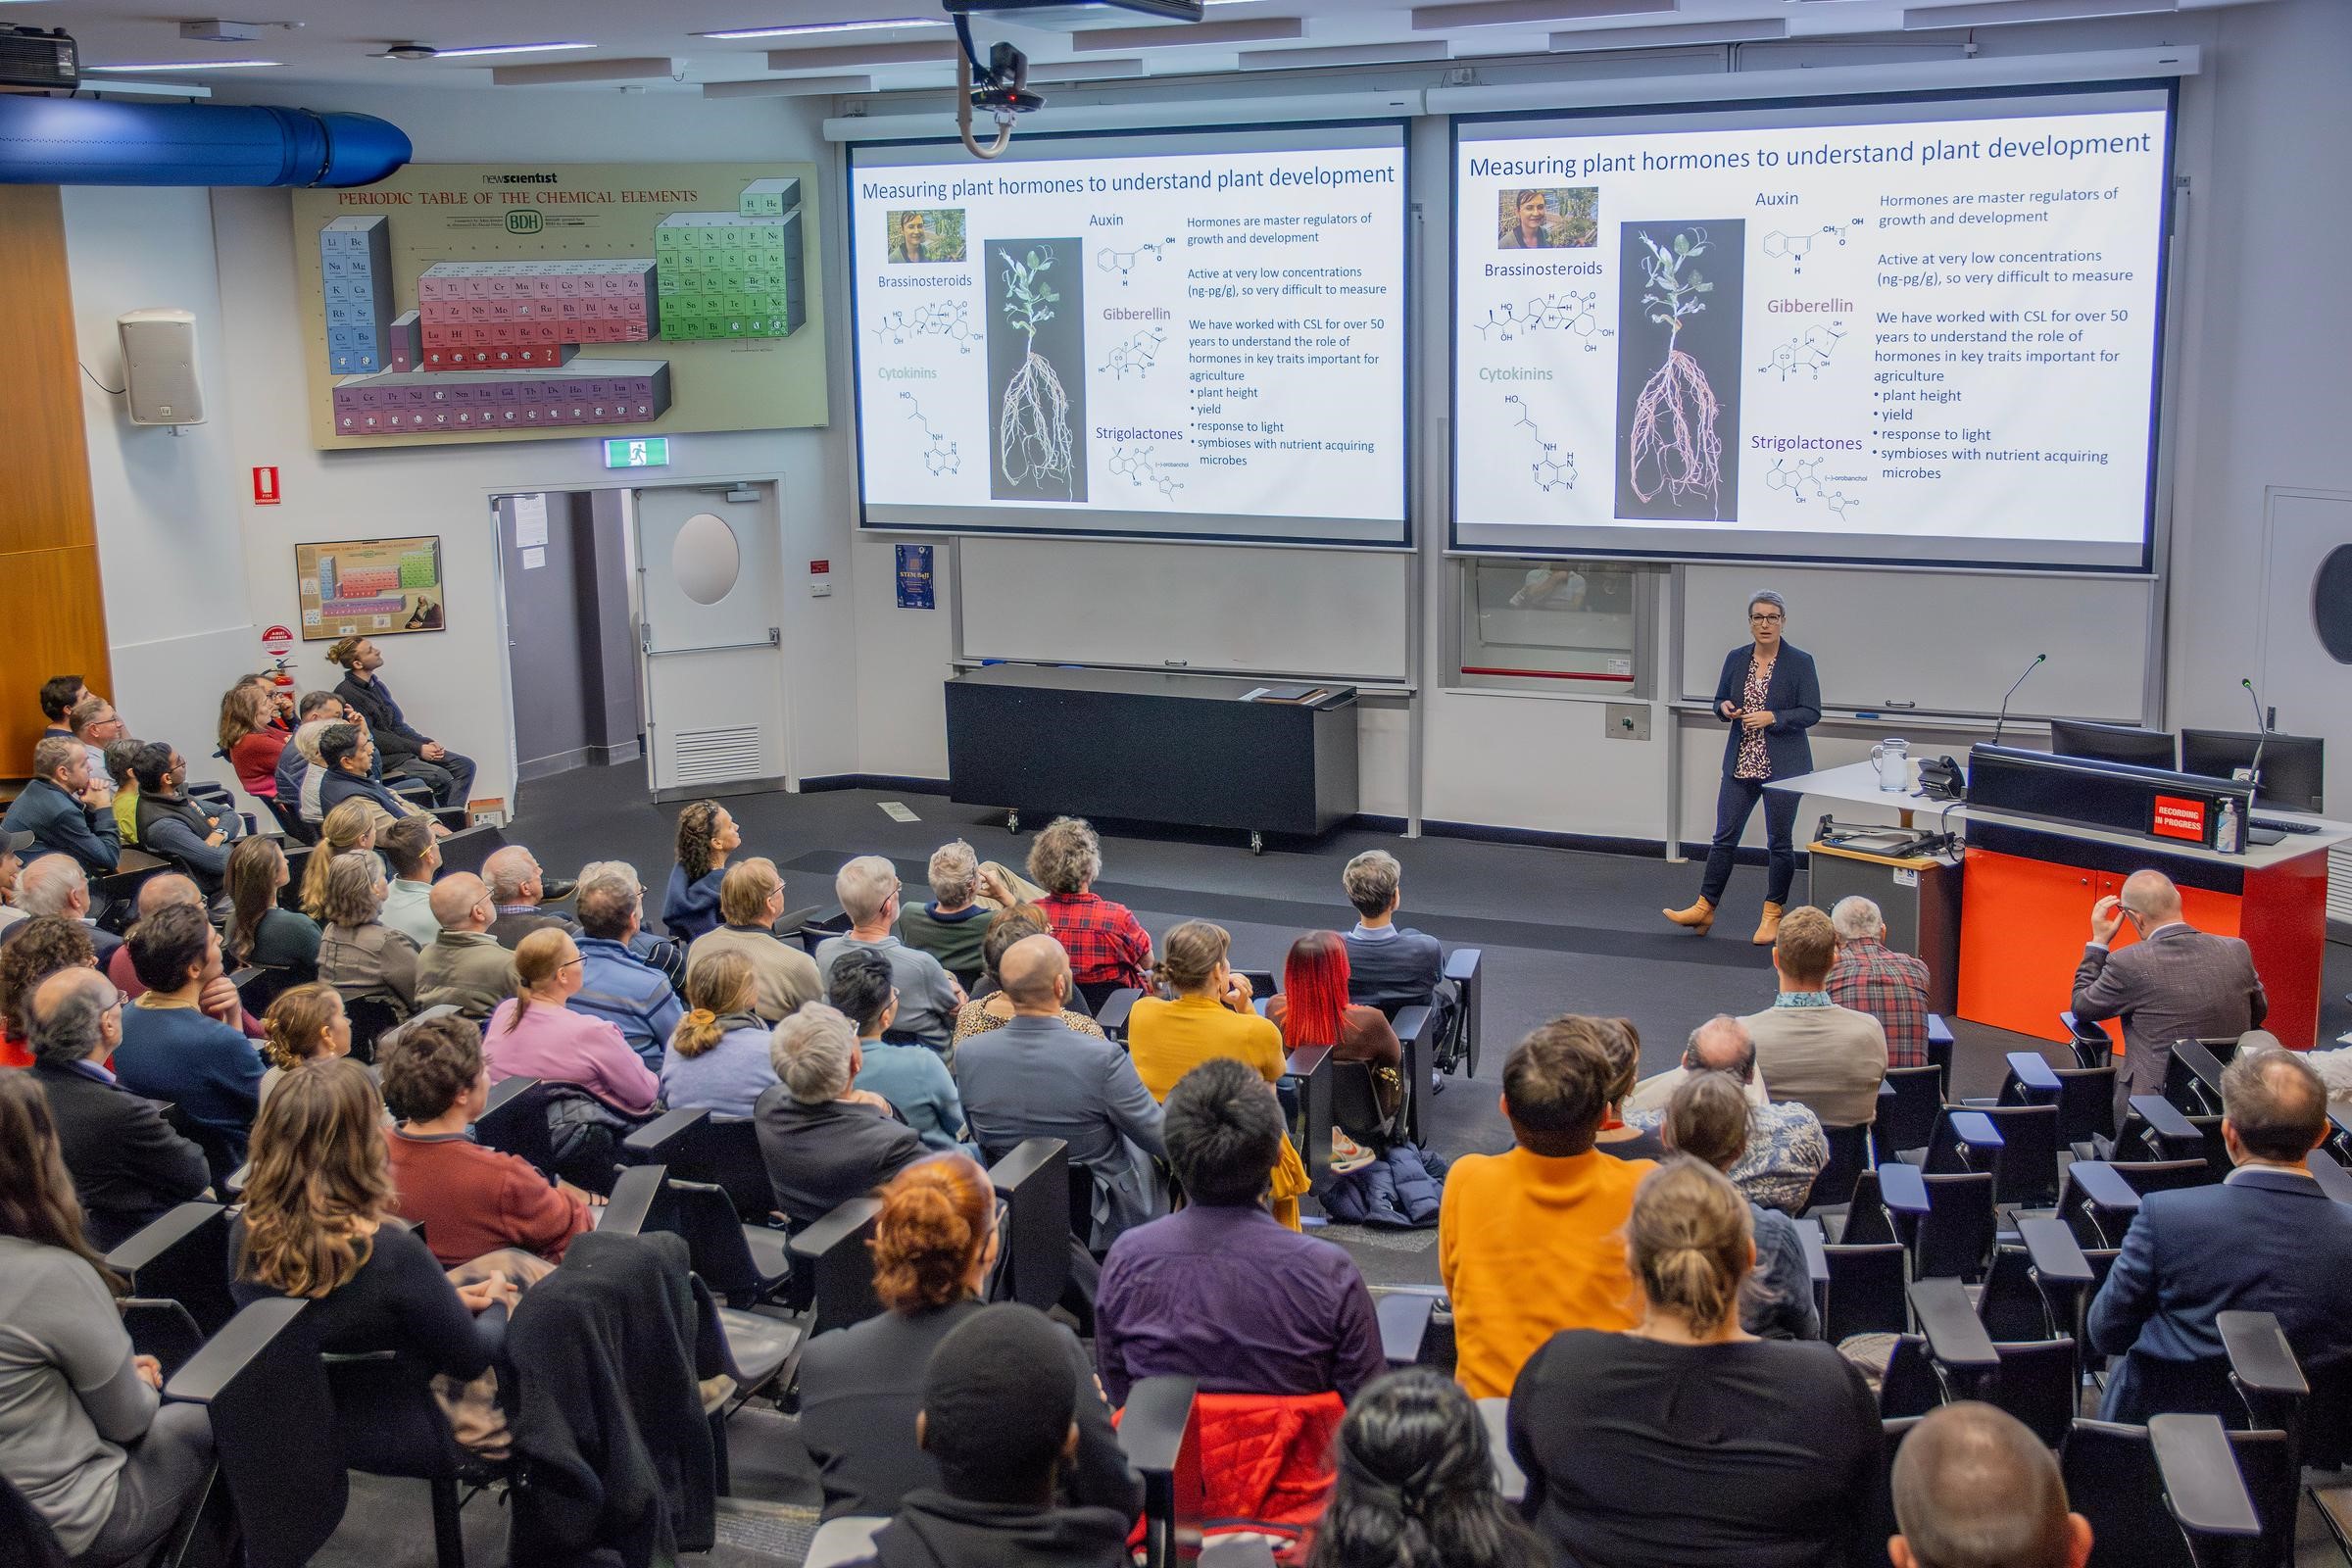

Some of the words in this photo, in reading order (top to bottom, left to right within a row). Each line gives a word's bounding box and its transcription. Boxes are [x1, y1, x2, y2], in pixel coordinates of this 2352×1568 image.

[1471, 156, 1576, 178] Measuring
[1584, 153, 1636, 177] plant
[1643, 151, 1749, 171] hormones
[1757, 149, 1779, 167] to
[1788, 141, 1913, 166] understand
[1923, 139, 1981, 166] plant
[1988, 133, 2150, 160] development
[863, 181, 947, 201] Measuring
[953, 179, 994, 200] plant
[1000, 177, 1083, 194] hormones
[1089, 176, 1105, 191] to
[1113, 170, 1210, 191] understand
[1218, 170, 1263, 192] plant
[1270, 167, 1395, 188] development
[338, 192, 413, 205] PERIODIC
[418, 192, 468, 205] TABLE
[473, 192, 494, 204] OF
[502, 192, 531, 204] THE
[536, 191, 616, 204] CHEMICAL
[621, 190, 698, 203] ELEMENTS
[1755, 192, 1798, 206] Auxin
[1881, 196, 1948, 207] Hormones
[1953, 195, 1974, 204] are
[1979, 192, 2025, 203] master
[2030, 189, 2099, 204] regulators
[2104, 187, 2119, 199] of
[510, 215, 538, 229] BDH
[1090, 214, 1123, 226] Auxin
[1188, 218, 1241, 227] Hormones
[1264, 216, 1300, 225] master
[1303, 214, 1357, 226] regulators
[1360, 213, 1372, 223] of
[1879, 214, 1926, 228] growth
[1931, 213, 1954, 224] and
[1959, 212, 2048, 227] development
[1188, 233, 1223, 247] growth
[1227, 233, 1246, 243] and
[1250, 232, 1319, 245] development
[1878, 253, 1918, 265] Active
[1922, 254, 1935, 265] at
[1939, 255, 1967, 266] very
[1972, 252, 1996, 264] low
[1999, 250, 2102, 264] concentrations
[328, 262, 341, 270] Na
[353, 262, 366, 270] Mg
[1486, 260, 1602, 276] Brassinosteroids
[879, 274, 972, 288] Brassinosteroids
[1187, 269, 1219, 279] Active
[1223, 270, 1233, 278] at
[1236, 270, 1257, 281] very
[1261, 268, 1279, 278] low
[1283, 268, 1362, 278] concentrations
[1878, 271, 1941, 287] (ng-pg/g),
[1965, 274, 1993, 285] very
[1997, 270, 2049, 282] difficult
[2054, 271, 2069, 281] to
[2073, 272, 2132, 281] measure
[1189, 284, 1239, 298] (ng-pg/g),
[1256, 287, 1279, 297] very
[1282, 284, 1323, 297] difficult
[1325, 285, 1337, 295] to
[1768, 298, 1853, 314] Gibberellin
[1103, 307, 1171, 320] Gibberellin
[1877, 313, 1897, 323] We
[1902, 312, 1932, 323] have
[1936, 311, 1984, 322] worked
[1989, 311, 2019, 321] with
[2024, 311, 2047, 321] CSL
[2051, 310, 2071, 321] for
[2076, 313, 2106, 321] over
[2111, 310, 2128, 321] 50
[1189, 319, 1205, 329] We
[1209, 319, 1232, 329] have
[1236, 318, 1274, 329] worked
[1277, 318, 1299, 329] with
[1303, 319, 1323, 329] CSL
[1326, 318, 1342, 329] for
[1344, 320, 1367, 329] over
[1371, 318, 1384, 329] 50
[1189, 338, 1215, 349] years
[1218, 337, 1229, 346] to
[1232, 336, 1291, 347] understand
[1295, 336, 1312, 346] the
[1316, 335, 1336, 346] role
[1340, 336, 1350, 346] of
[1875, 330, 1909, 344] years
[1913, 332, 1926, 342] to
[1931, 330, 2007, 343] understand
[2011, 330, 2033, 343] the
[2038, 329, 2064, 342] role
[2069, 329, 2083, 342] of
[1189, 353, 1242, 365] hormones
[1245, 354, 1253, 364] in
[1257, 353, 1274, 366] key
[1277, 354, 1305, 364] traits
[1308, 354, 1361, 367] important
[1364, 354, 1379, 366] for
[1876, 350, 1940, 362] hormones
[1945, 350, 1956, 361] in
[1961, 350, 1984, 365] key
[1987, 350, 2022, 362] traits
[2027, 350, 2095, 365] important
[2100, 350, 2120, 362] for
[878, 367, 938, 381] Cytokinins
[1189, 370, 1246, 382] agriculture
[1478, 366, 1552, 383] Cytokinins
[1874, 369, 1943, 384] agriculture
[1198, 386, 1223, 400] plant
[1226, 386, 1258, 400] height
[1884, 389, 1916, 403] plant
[1921, 389, 1962, 404] height
[1198, 404, 1221, 416] yield
[1883, 409, 1912, 422] yield
[1097, 427, 1183, 442] Strigolactones
[1198, 423, 1244, 433] response
[1247, 422, 1258, 431] to
[1261, 421, 1284, 434] light
[1883, 431, 1940, 442] response
[1944, 429, 1958, 440] to
[1963, 428, 1991, 443] light
[1198, 438, 1250, 449] symbioses
[1254, 439, 1276, 449] with
[1280, 439, 1322, 451] nutrient
[1325, 440, 1374, 454] acquiring
[1751, 435, 1863, 452] Strigolactones
[1200, 455, 1247, 466] microbes
[1882, 447, 1947, 461] symbioses
[1952, 448, 1981, 460] with
[1986, 449, 2040, 461] nutrient
[2044, 450, 2108, 465] acquiring
[1883, 466, 1940, 478] microbes
[2159, 806, 2199, 819] RECORDING
[2155, 815, 2163, 824] IN
[2164, 817, 2201, 831] PROGRESS
